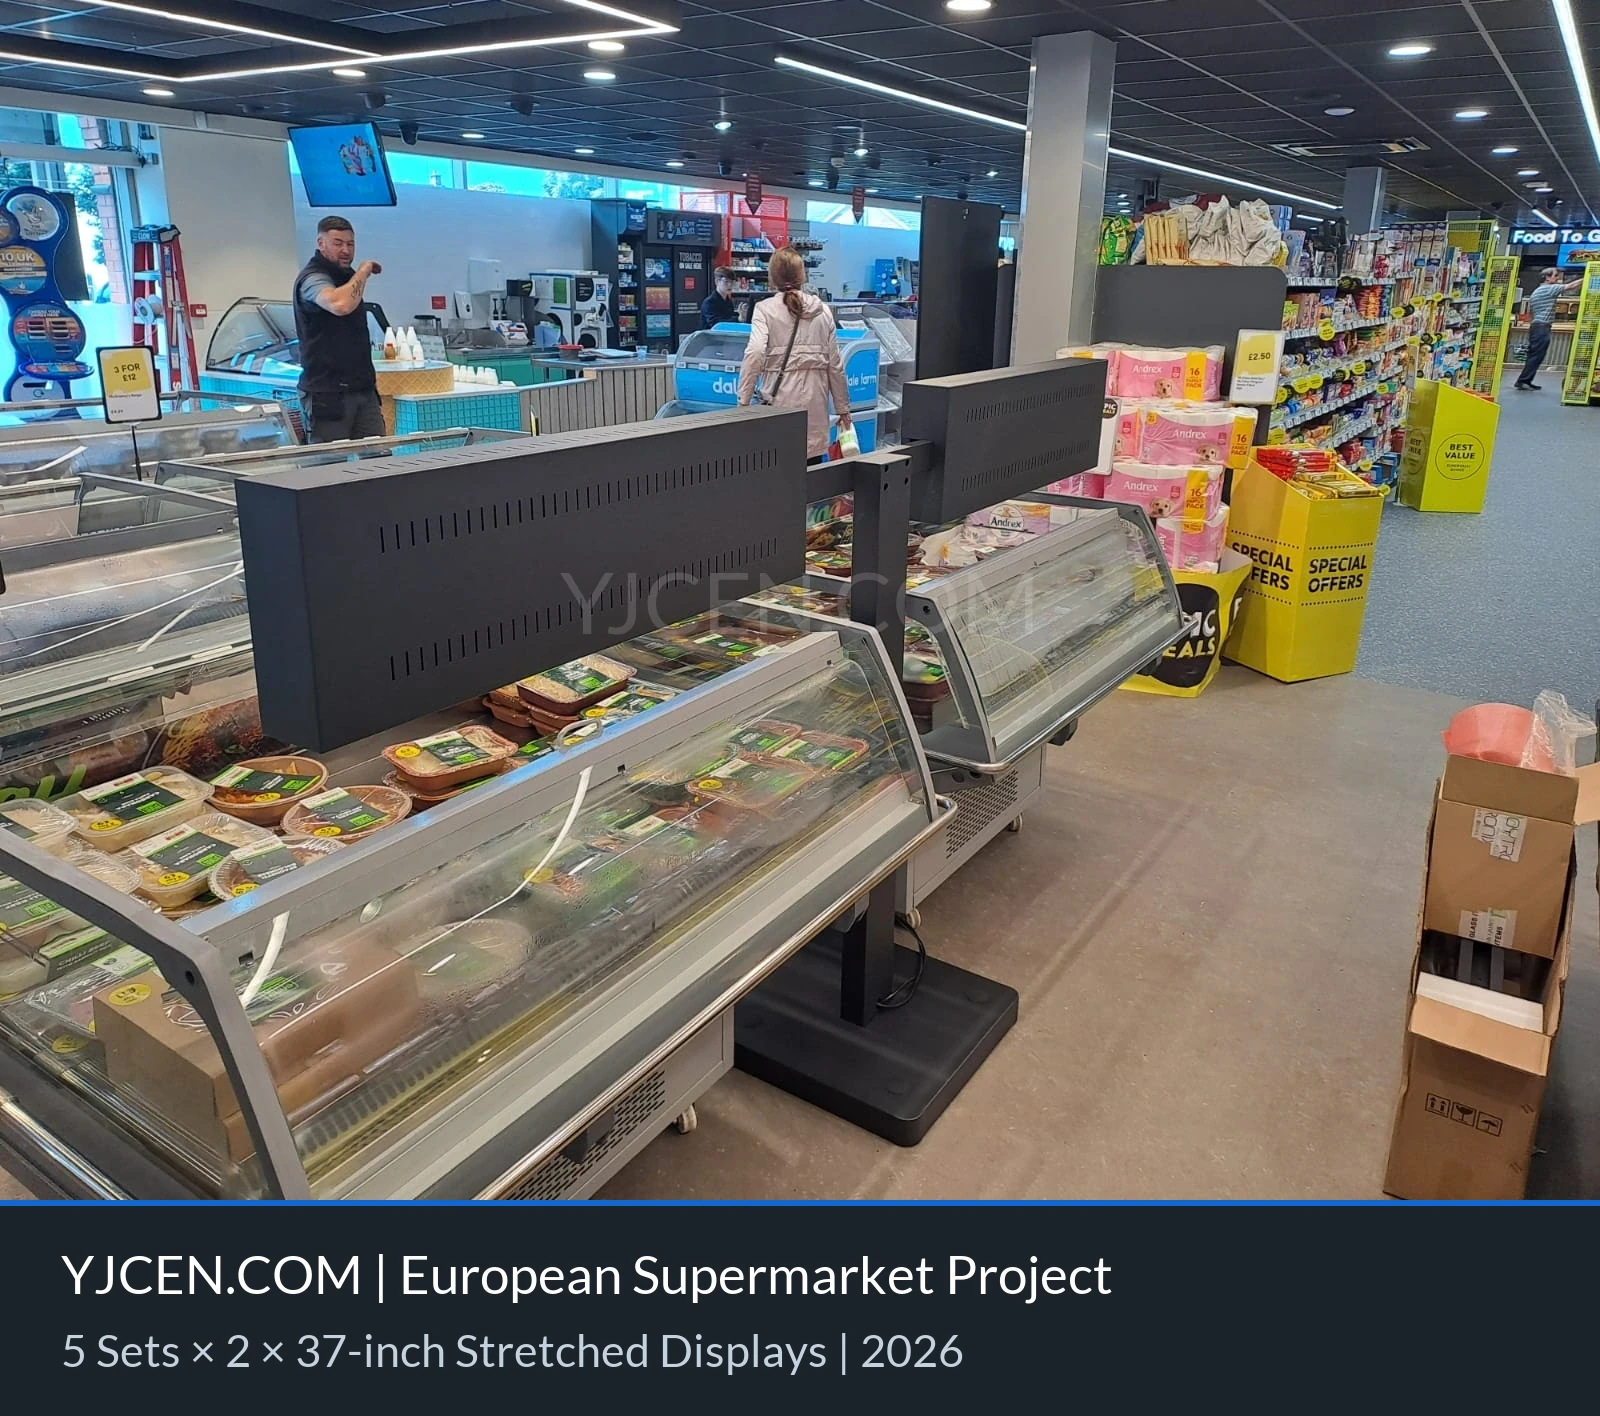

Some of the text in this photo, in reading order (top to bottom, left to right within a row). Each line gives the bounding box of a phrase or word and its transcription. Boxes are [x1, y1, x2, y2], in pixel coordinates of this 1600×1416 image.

[1512, 229, 1557, 244] Food
[1560, 229, 1583, 244] To
[17, 252, 35, 262] UK
[1247, 352, 1271, 361] £2.50
[113, 363, 141, 374] 3 FOR
[1132, 364, 1162, 374] Andrex
[1190, 367, 1200, 376] 16
[122, 373, 137, 382] £12
[860, 372, 877, 385] farm
[712, 376, 739, 395] dal
[1171, 429, 1207, 440] Andrex
[1236, 433, 1247, 444] 16
[1449, 443, 1474, 451] BEST
[1444, 451, 1477, 460] VALUE
[1123, 480, 1159, 492] Andrex
[1191, 488, 1202, 497] 16
[990, 516, 1022, 528] Andrex
[1308, 555, 1368, 574] SPECIAL
[1250, 566, 1290, 591] FERS
[1308, 573, 1364, 593] OFFERS
[1162, 636, 1216, 659] EALS
